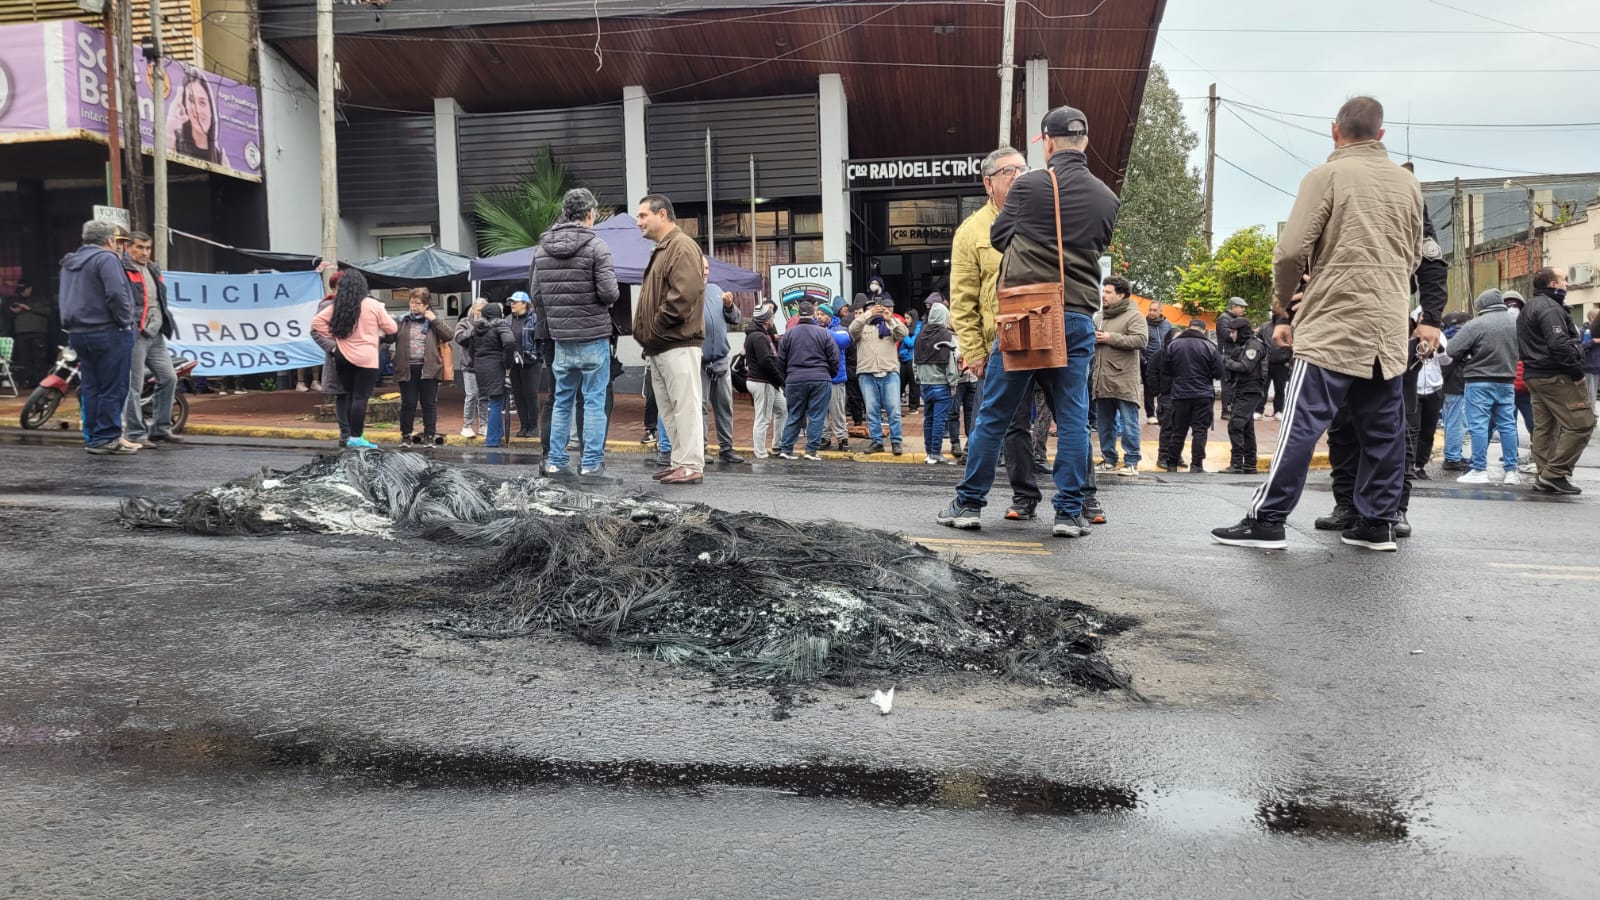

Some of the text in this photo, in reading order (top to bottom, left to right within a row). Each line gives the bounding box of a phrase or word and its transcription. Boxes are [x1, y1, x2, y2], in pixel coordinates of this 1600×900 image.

[869, 157, 984, 179] RADIOELECTRIC
[777, 266, 832, 279] POLICIA
[174, 282, 290, 304] LICIA
